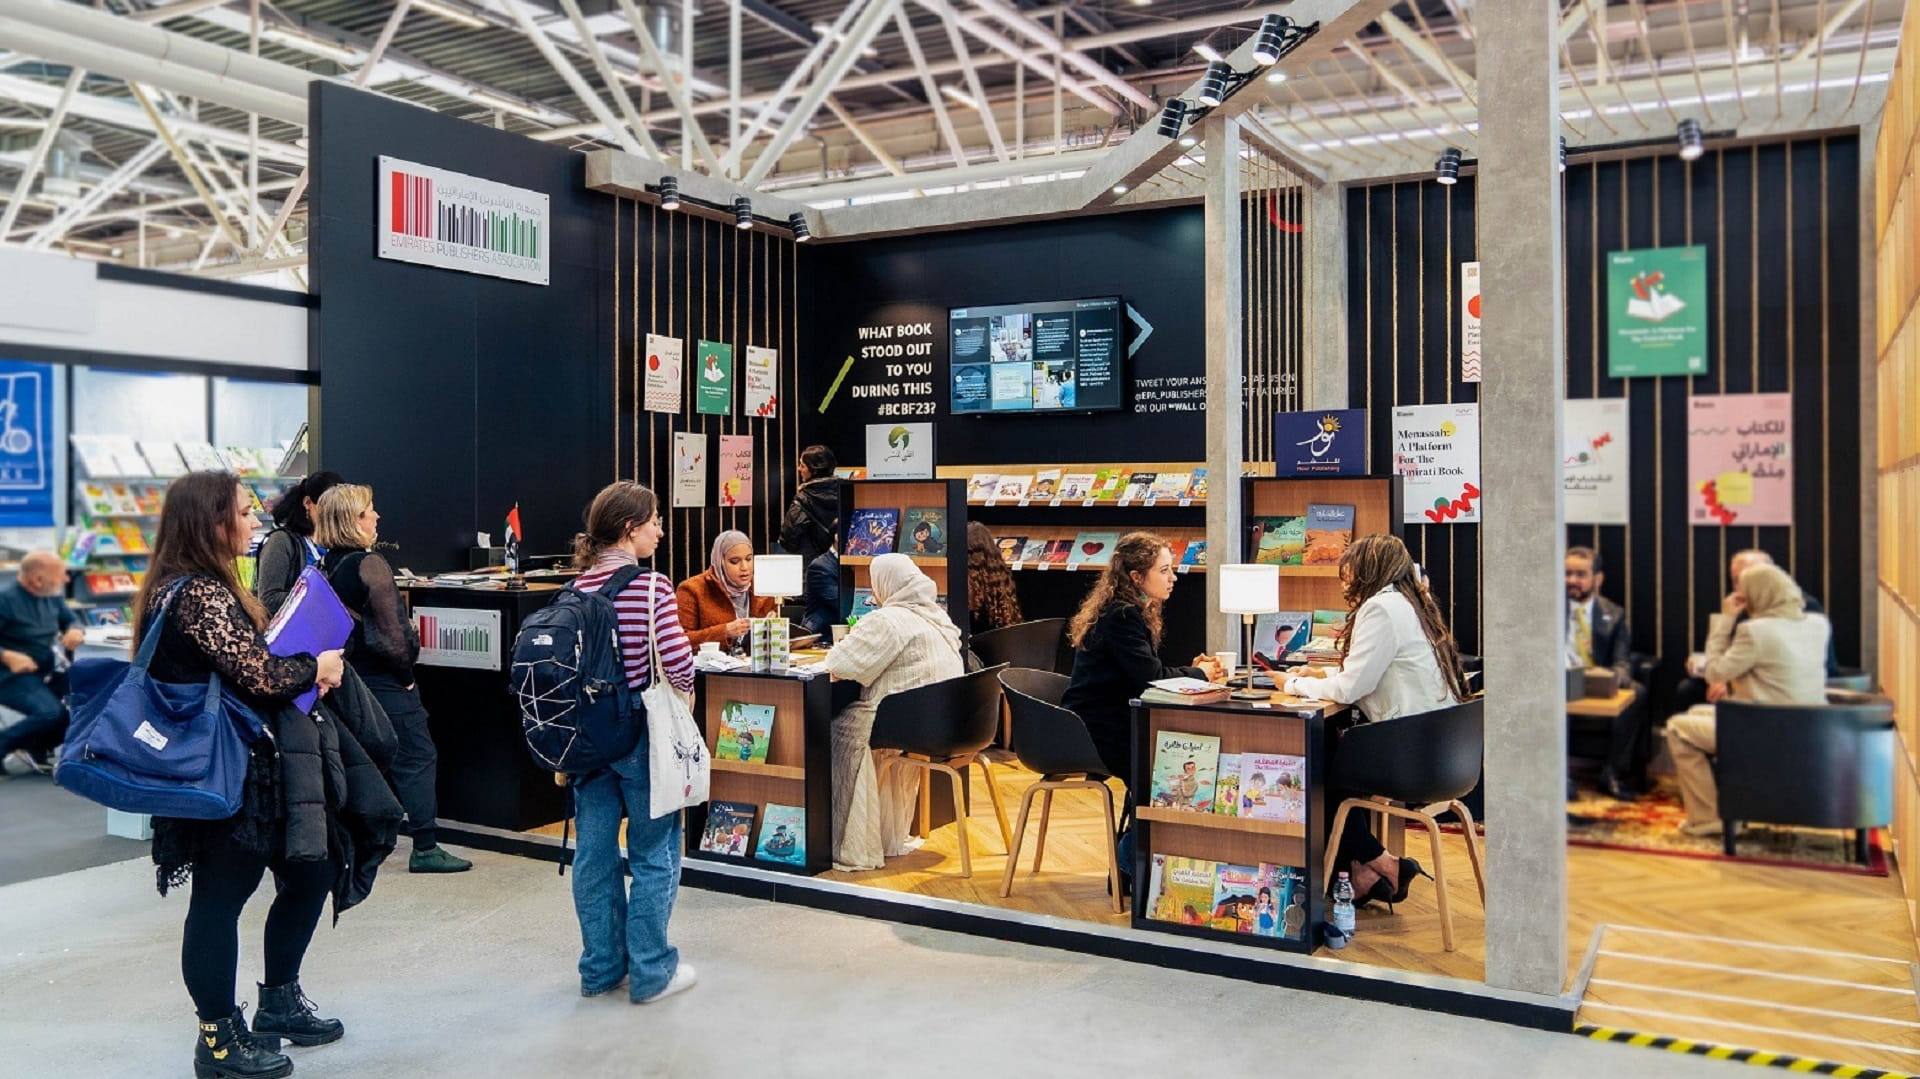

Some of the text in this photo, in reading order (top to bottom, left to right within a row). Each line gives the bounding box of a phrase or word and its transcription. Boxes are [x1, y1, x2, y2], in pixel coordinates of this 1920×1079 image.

[391, 235, 541, 272] EMIRATES PUBLISHERS ASSOCIATION
[858, 322, 932, 340] WHAT BOOK
[861, 343, 933, 359] STOOD OUT
[885, 362, 932, 377] TO YOU
[1135, 378, 1164, 388] TWEET
[1165, 377, 1188, 387] YOUR
[1189, 376, 1207, 386] ANS
[852, 382, 933, 398] DURING THIS
[1135, 388, 1207, 402] @EPA_PUBLISHERS
[877, 401, 937, 416] #BCBF23?
[1135, 404, 1148, 413] ON
[1149, 403, 1167, 413] OUR
[1199, 402, 1206, 410] O
[1398, 428, 1451, 440] Menassah:
[1736, 420, 1785, 436] للكتاب
[1398, 441, 1452, 452] A Platform
[1398, 454, 1435, 465] For The
[1399, 466, 1464, 477] Emirati Book
